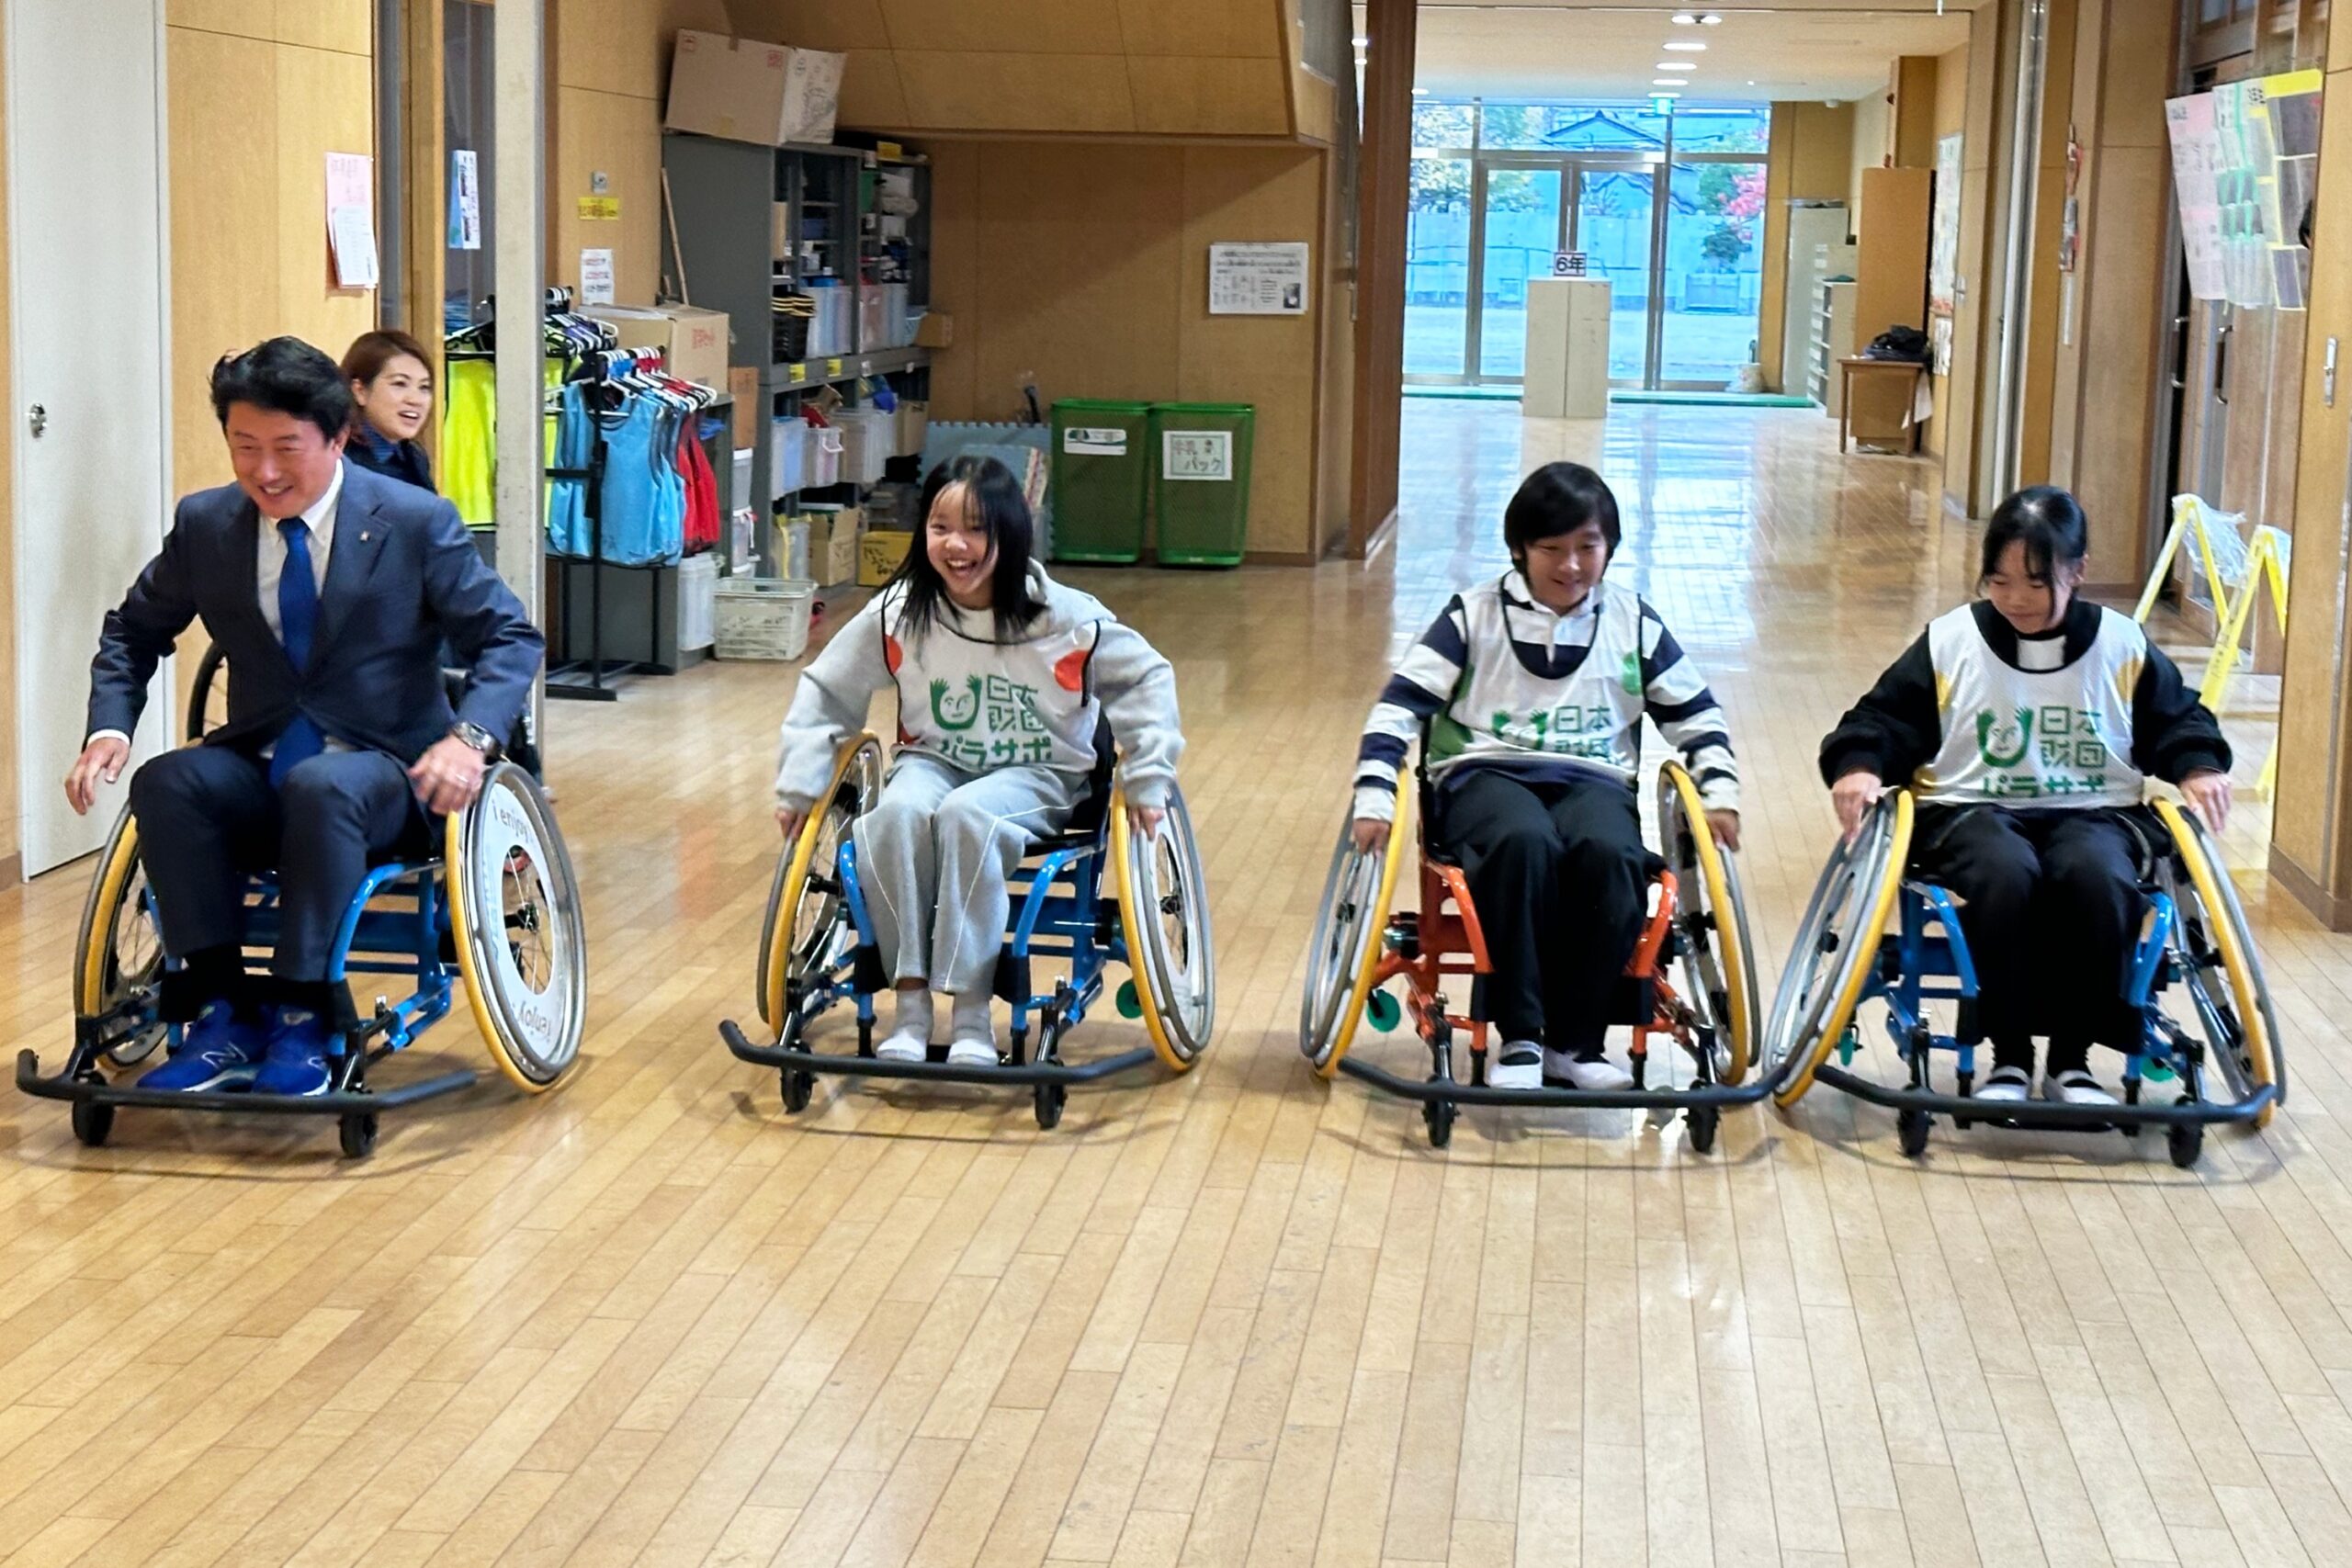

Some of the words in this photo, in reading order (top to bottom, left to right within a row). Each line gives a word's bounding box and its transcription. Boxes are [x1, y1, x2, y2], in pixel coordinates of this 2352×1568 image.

[1556, 254, 1586, 274] 6年
[988, 674, 1038, 706] 日本
[1556, 705, 1611, 733] 日本
[2041, 706, 2102, 734] 日本
[940, 735, 1052, 767] パラサポ
[2040, 739, 2106, 768] 財団
